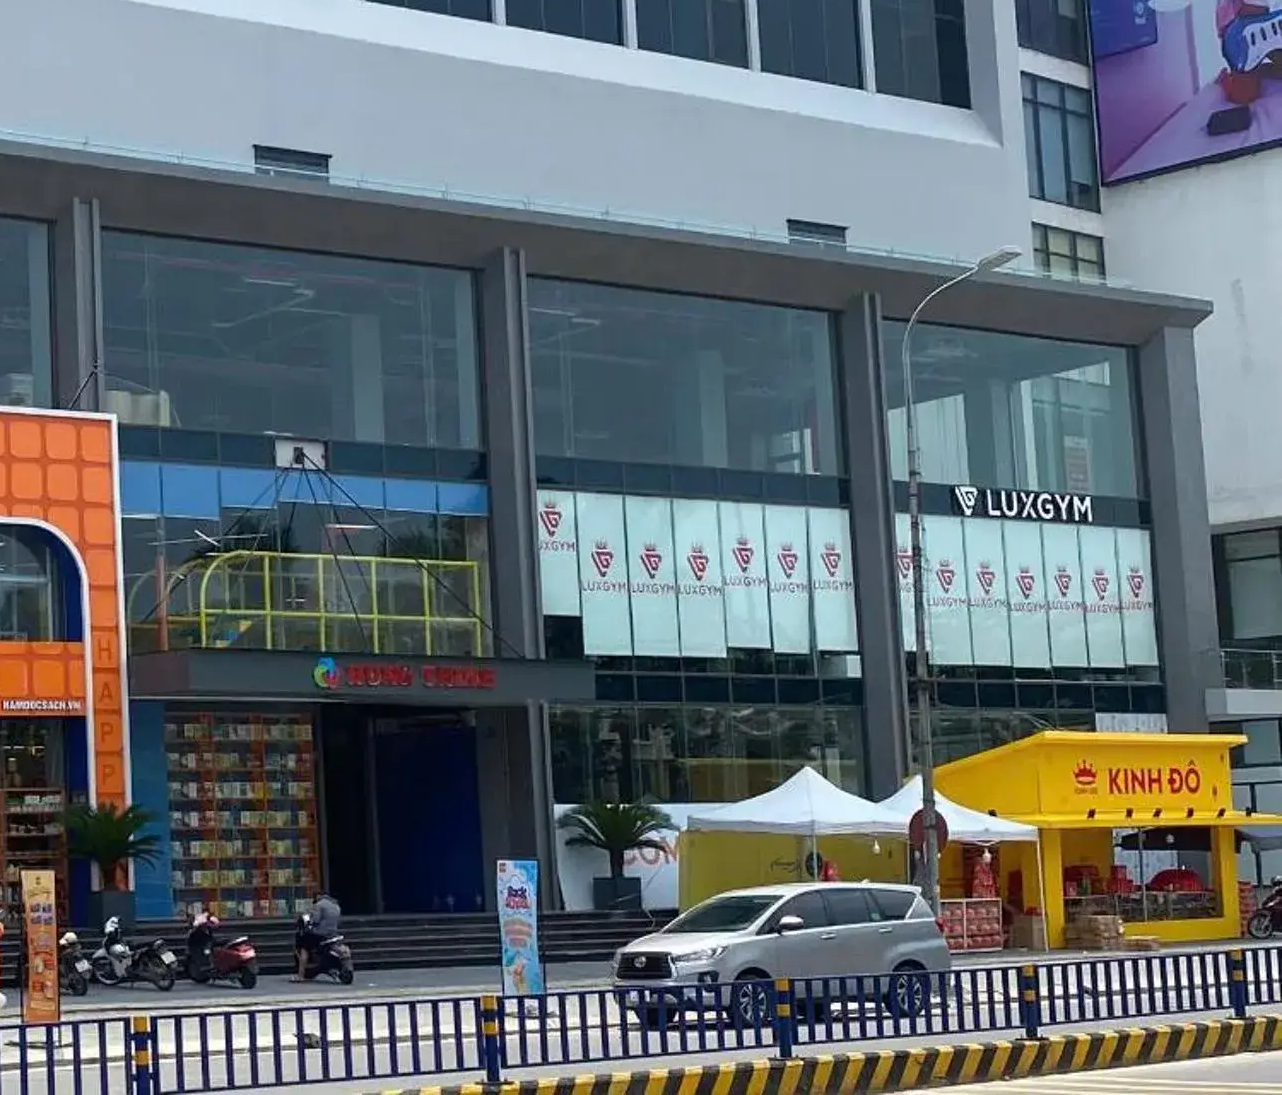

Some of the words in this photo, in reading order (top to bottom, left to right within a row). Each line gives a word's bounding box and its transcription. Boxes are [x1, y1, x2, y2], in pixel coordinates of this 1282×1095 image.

[987, 489, 1093, 522] LUXGYM
[582, 580, 626, 593] LUXGYM
[724, 575, 766, 588] LUXGYM
[813, 579, 853, 591] LUXGYM
[631, 582, 675, 595] LUXGYM
[677, 584, 722, 596] LUXGYM
[1108, 768, 1163, 795] KINH
[1168, 759, 1201, 794] ĐÔ
